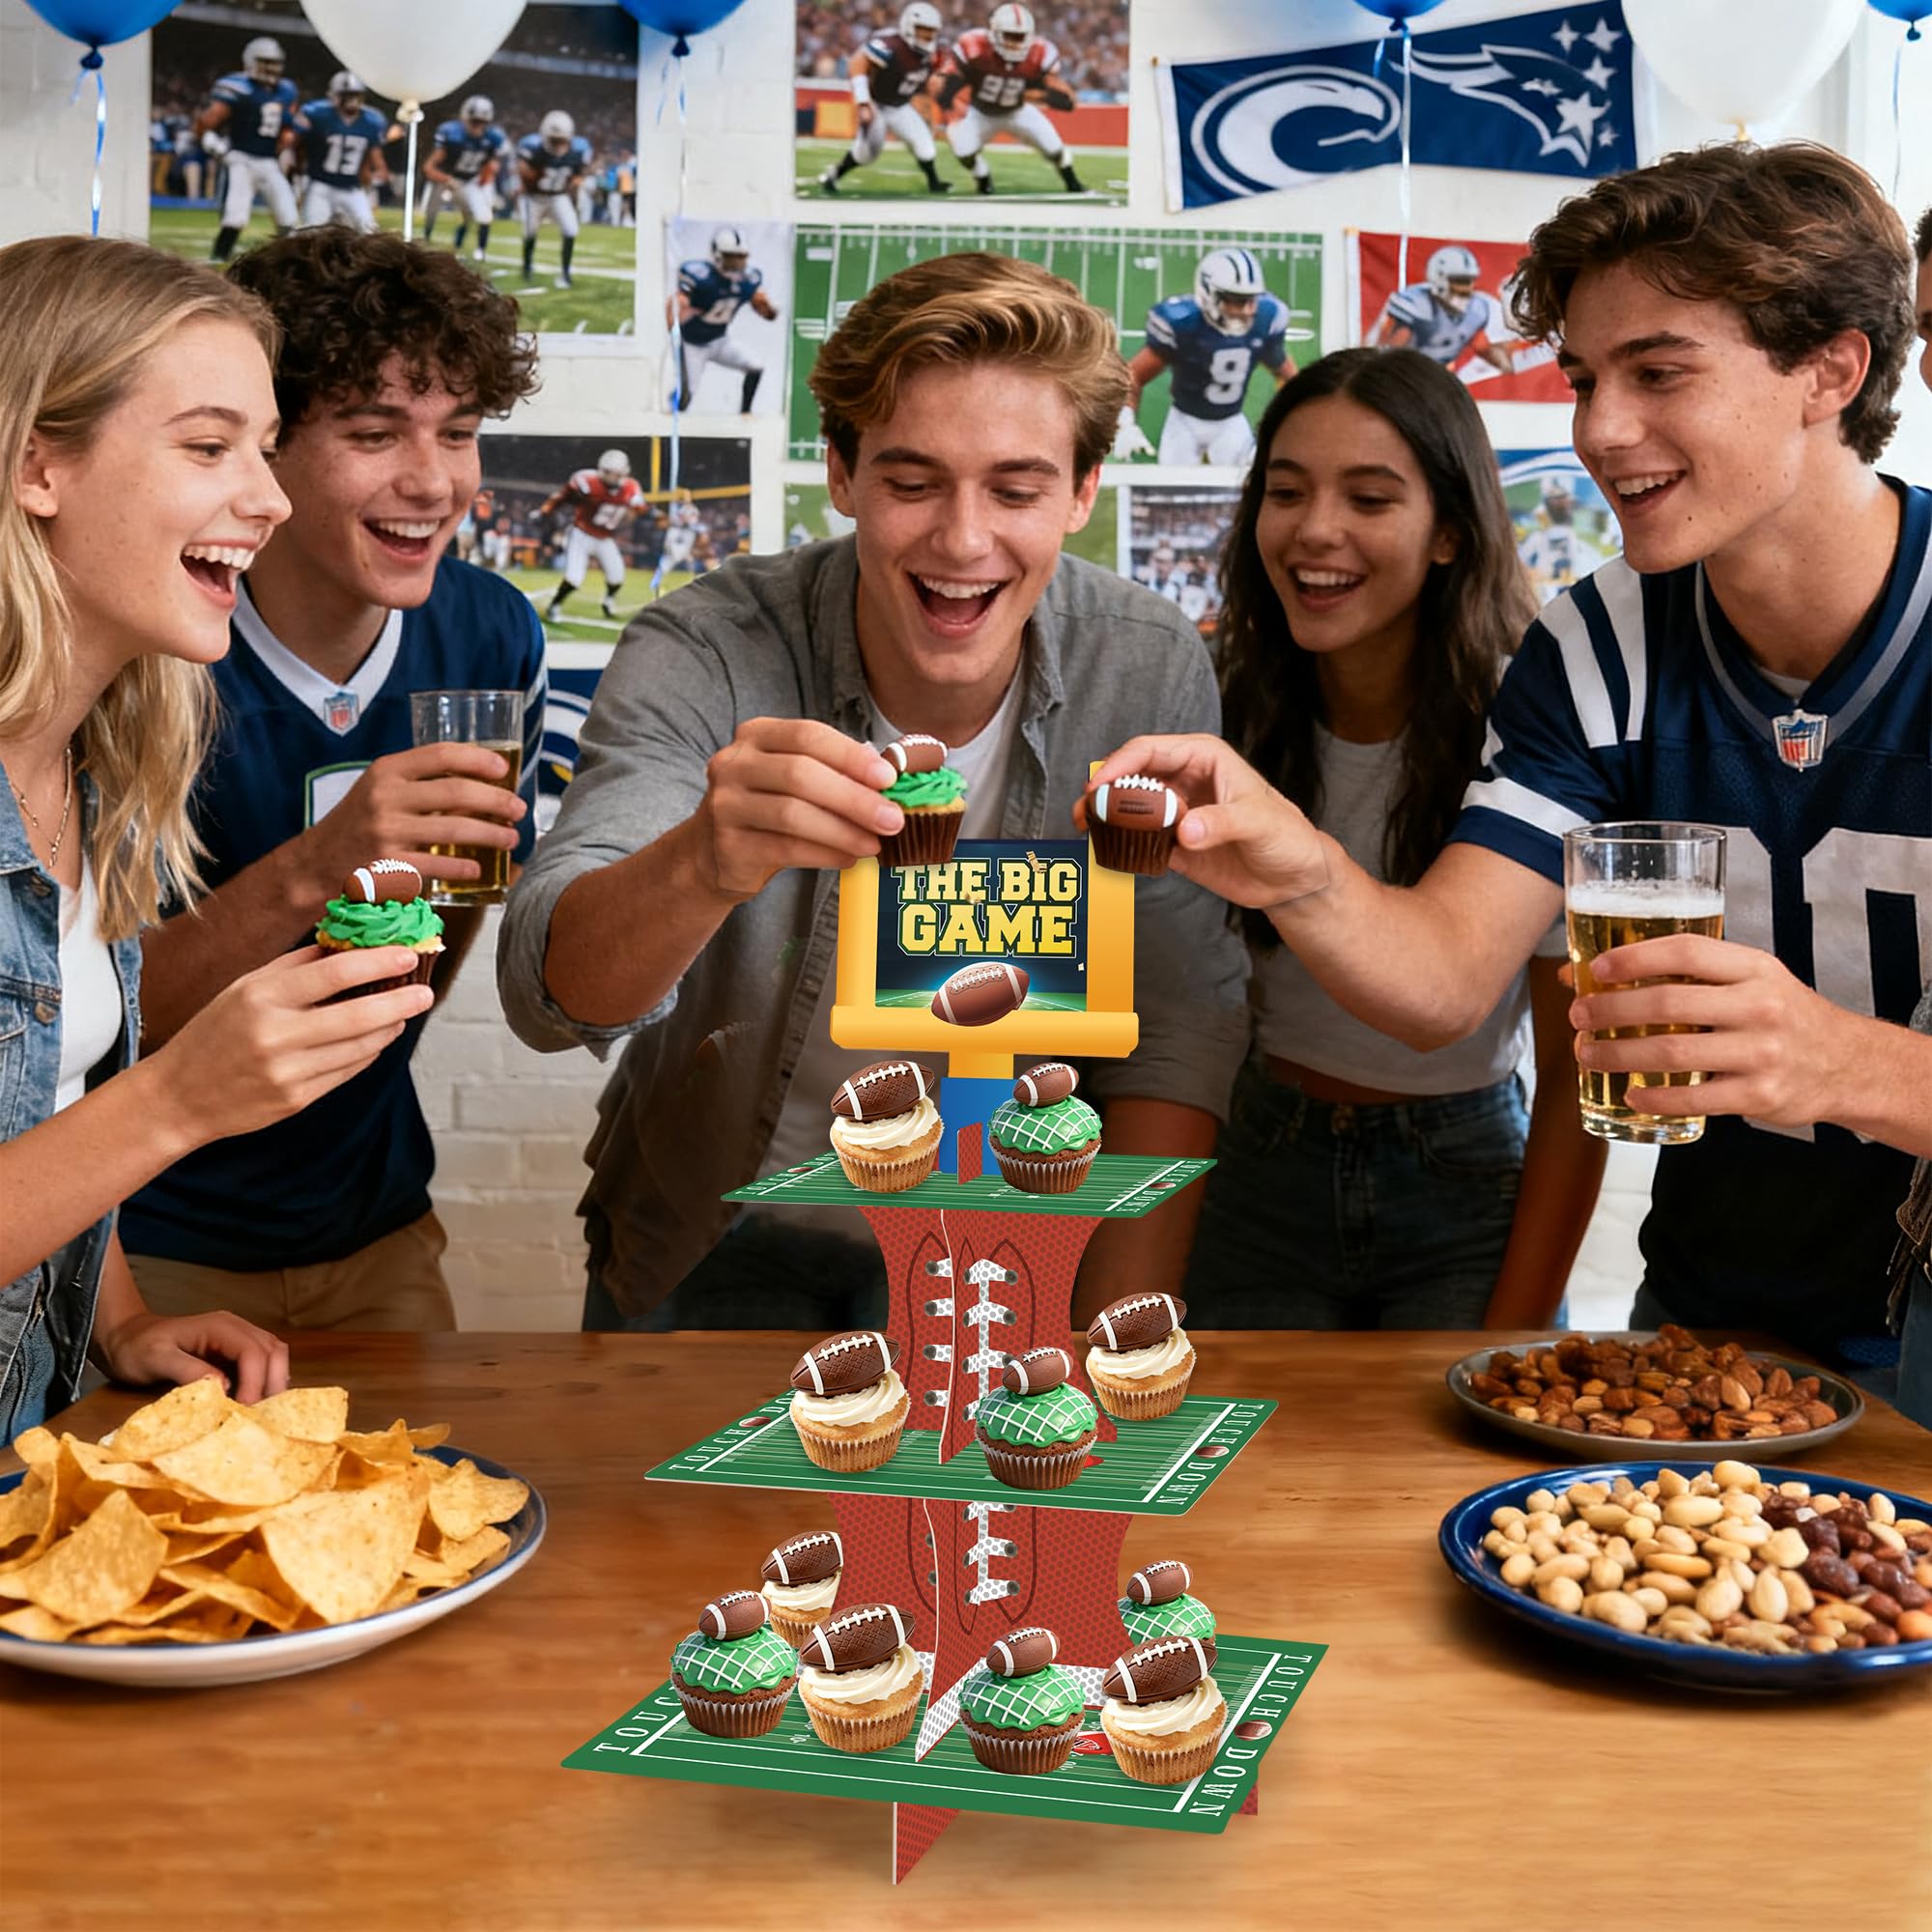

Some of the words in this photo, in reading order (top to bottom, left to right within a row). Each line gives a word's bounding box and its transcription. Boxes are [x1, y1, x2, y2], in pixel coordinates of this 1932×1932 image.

[1205, 347, 1252, 405] 9
[893, 861, 989, 902] THE
[999, 860, 1080, 903] BIG
[899, 902, 1075, 954] GAME
[668, 1428, 753, 1471] TOUCH
[1208, 1404, 1265, 1445] TOUCH
[1155, 1462, 1217, 1505] DOWN
[1249, 1654, 1313, 1719] TOUCH
[592, 1685, 682, 1753] TOUC
[1188, 1746, 1259, 1817] DOWN
